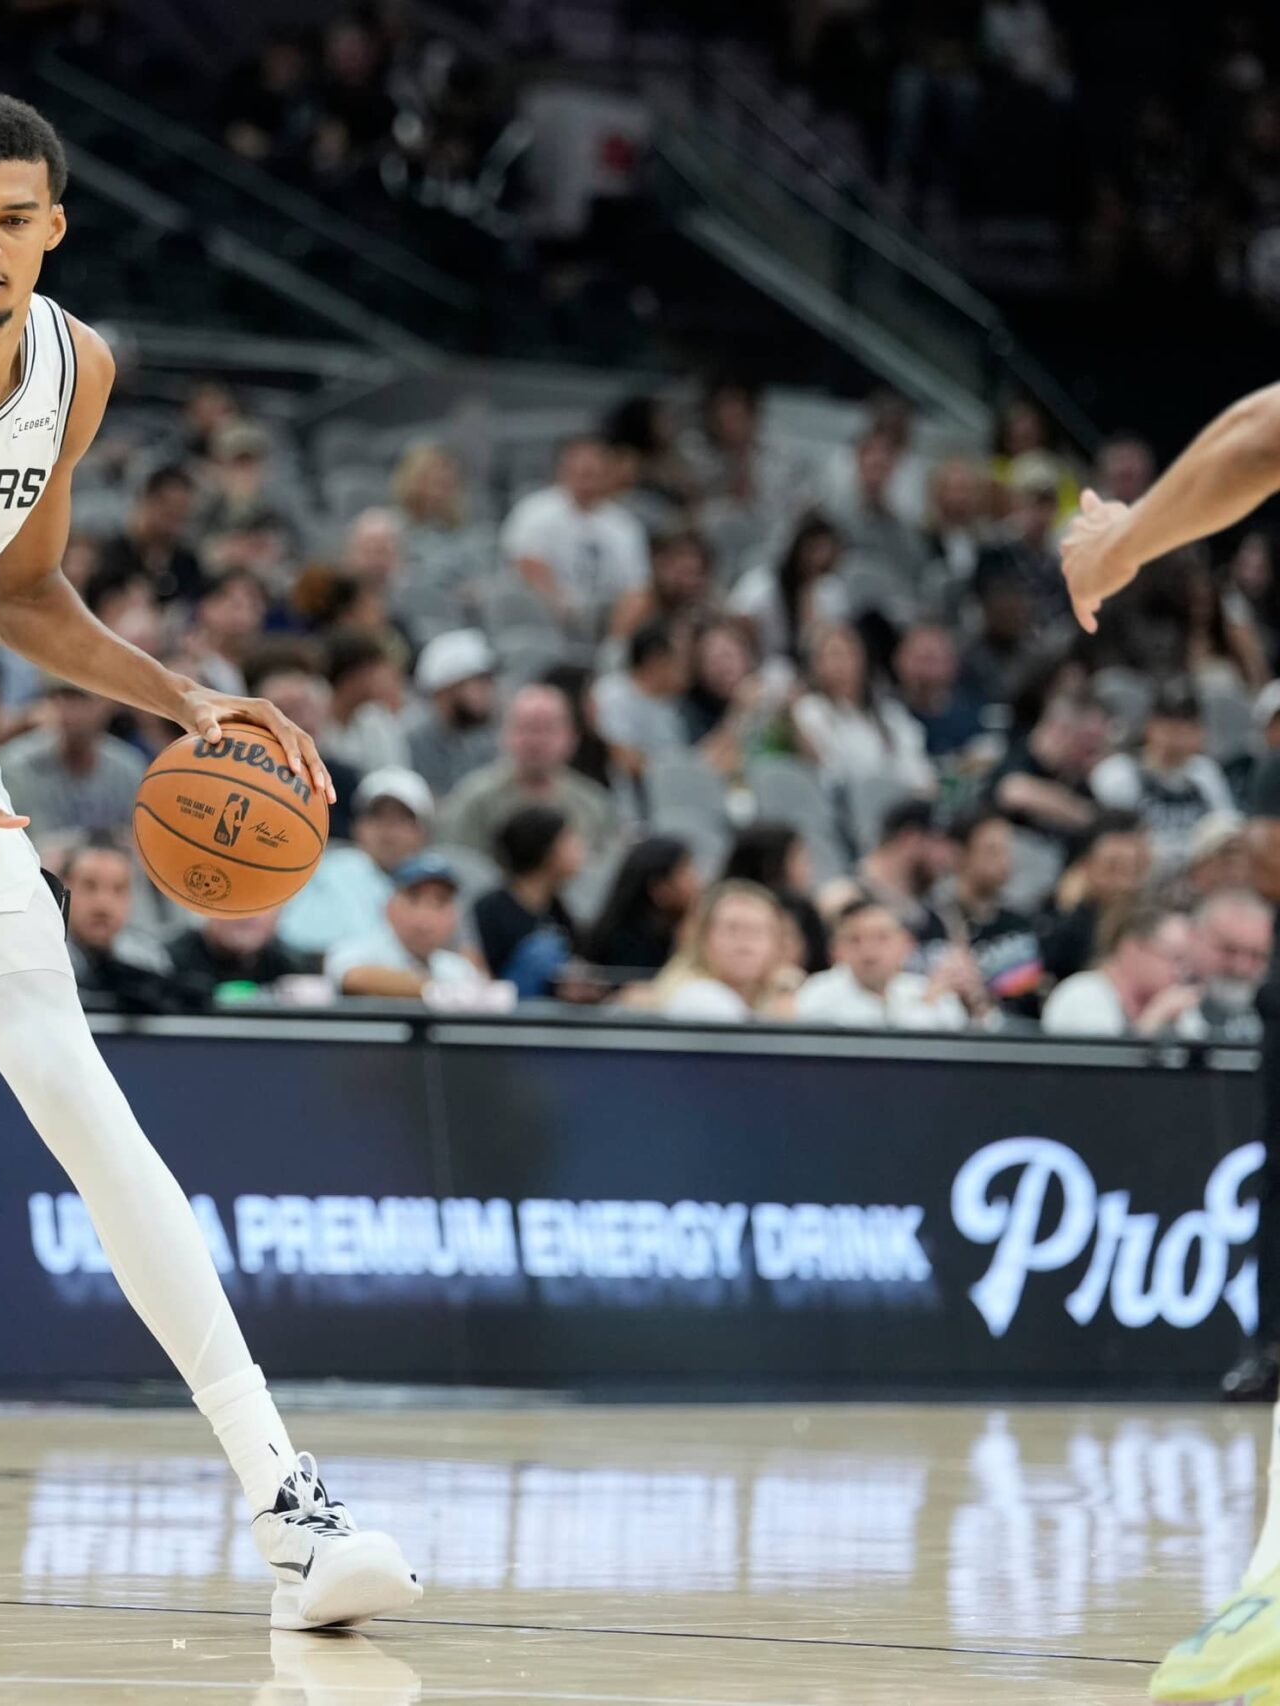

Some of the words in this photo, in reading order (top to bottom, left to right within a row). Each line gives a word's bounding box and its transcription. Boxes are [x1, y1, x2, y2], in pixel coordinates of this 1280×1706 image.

[18, 416, 51, 432] LEDGER
[193, 737, 312, 806] Wilson
[234, 1194, 517, 1276] PREMIUM
[518, 1199, 748, 1279] ENERGY
[751, 1203, 932, 1281] DRINK
